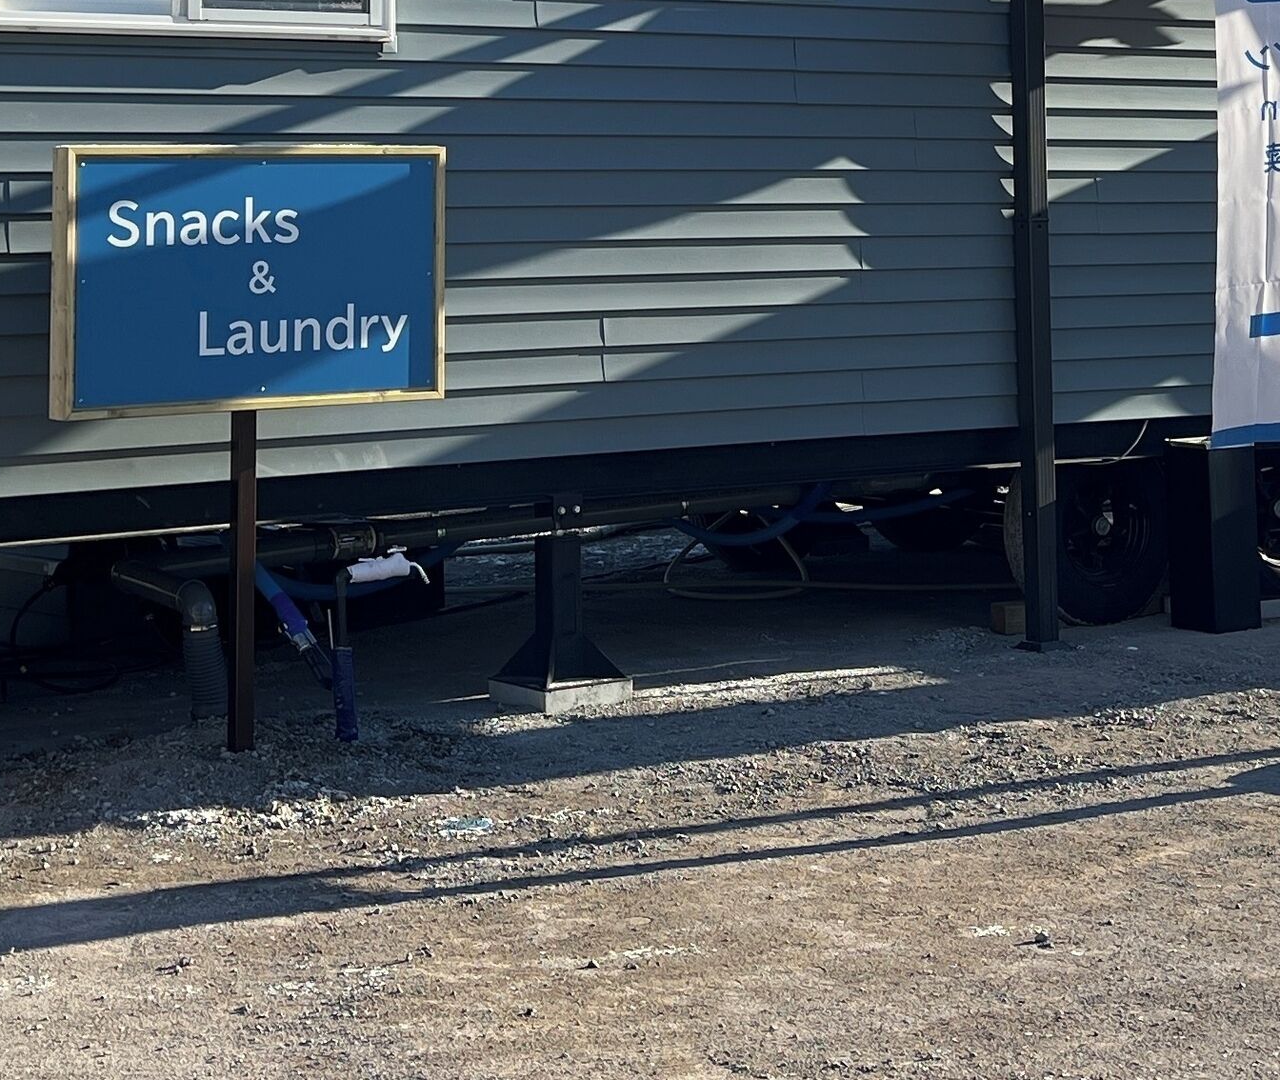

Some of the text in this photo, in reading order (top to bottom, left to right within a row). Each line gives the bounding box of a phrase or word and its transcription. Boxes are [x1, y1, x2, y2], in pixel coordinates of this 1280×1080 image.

[106, 196, 300, 249] Snacks
[248, 260, 277, 295] &
[198, 303, 409, 357] Laundry
